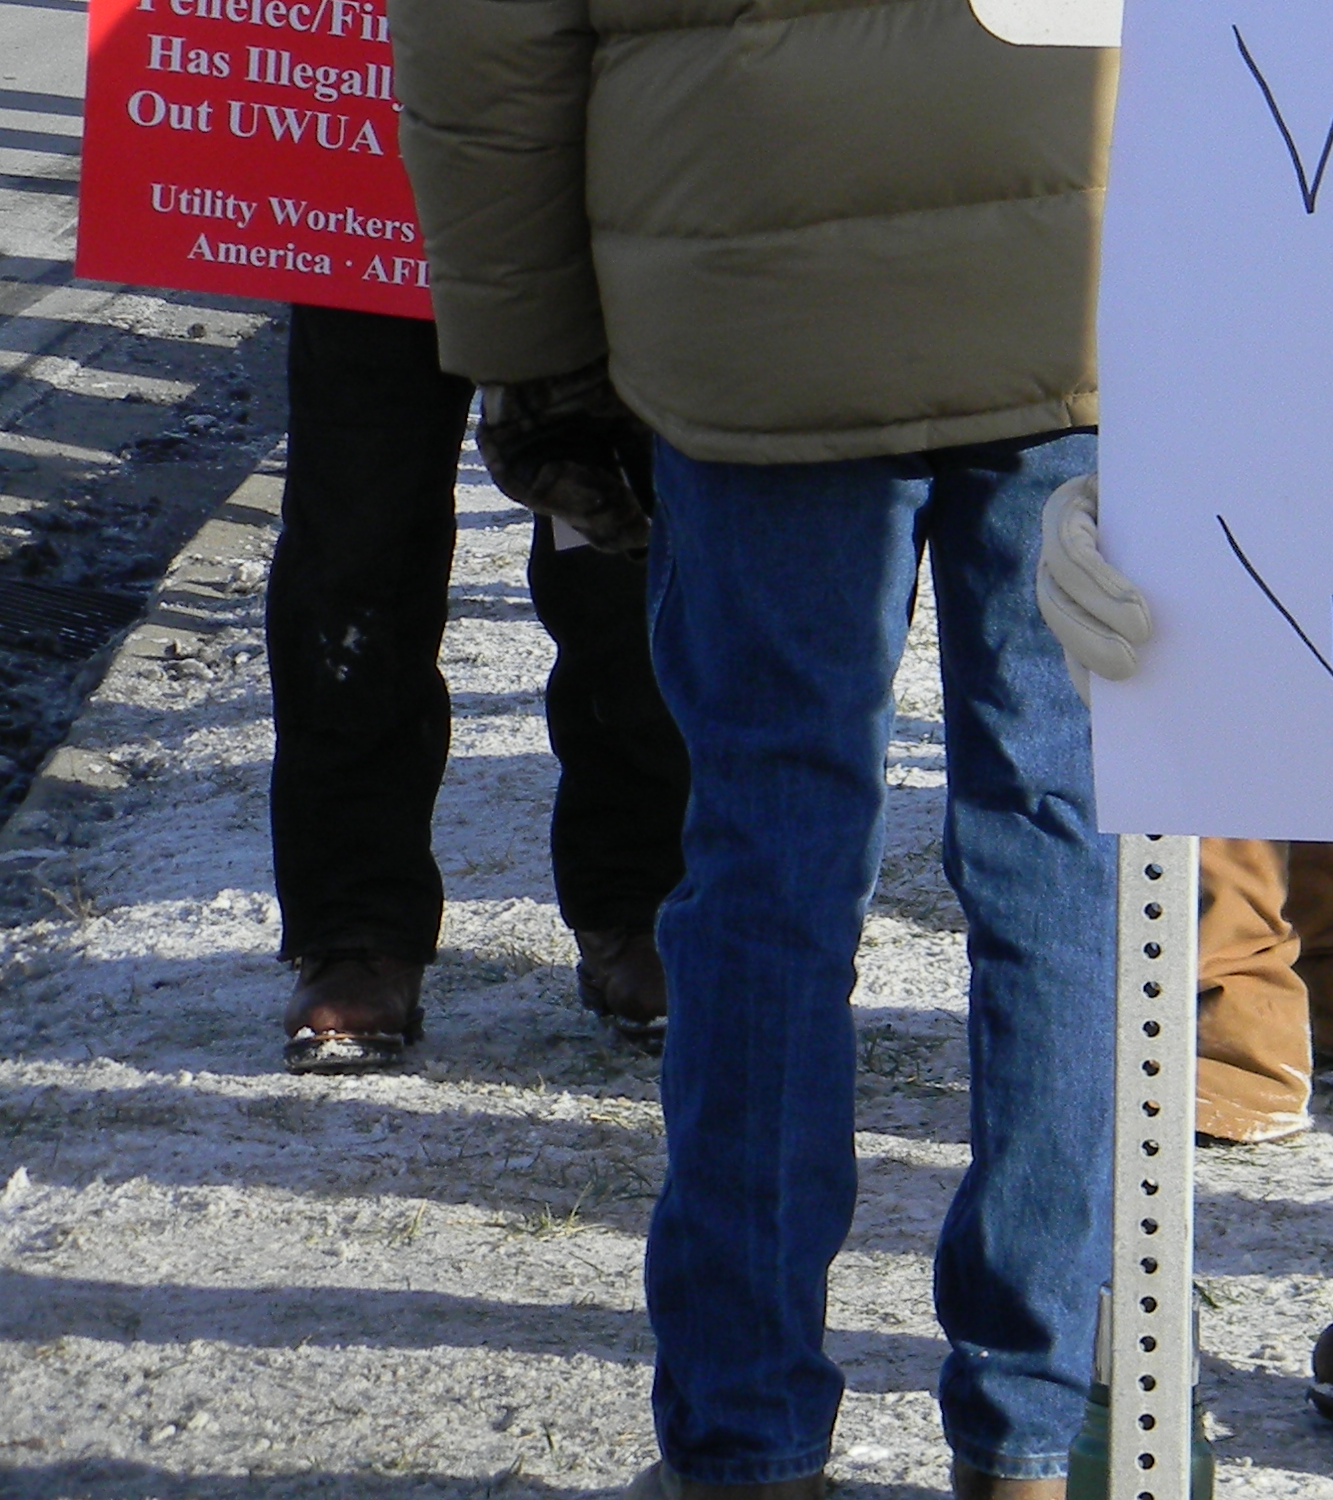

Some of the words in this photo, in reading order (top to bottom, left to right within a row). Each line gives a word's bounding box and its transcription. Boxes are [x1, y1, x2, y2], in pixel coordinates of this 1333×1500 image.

[146, 34, 231, 79] Has
[127, 89, 213, 133] Out
[227, 100, 384, 157] UWUA
[150, 182, 258, 229] Utility
[268, 196, 416, 243] Workers
[186, 232, 332, 276] America
